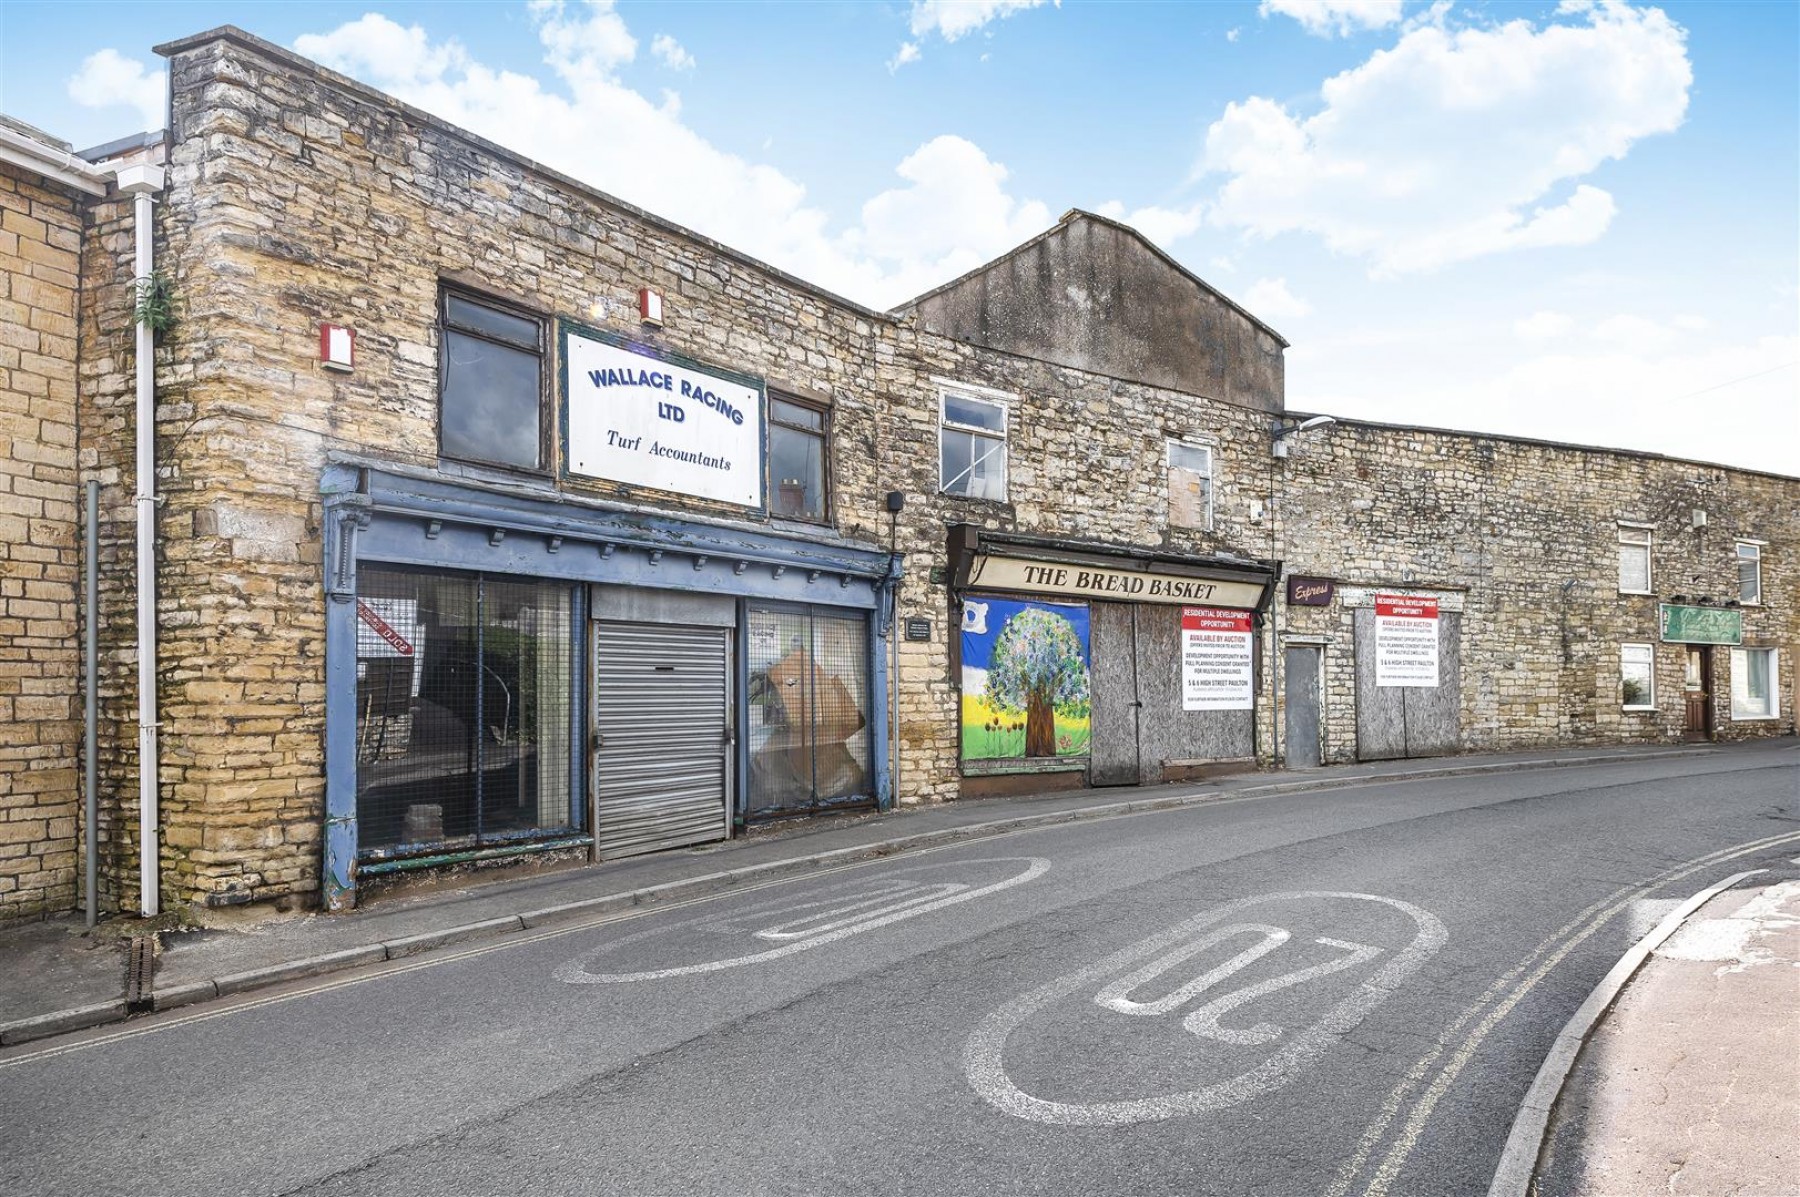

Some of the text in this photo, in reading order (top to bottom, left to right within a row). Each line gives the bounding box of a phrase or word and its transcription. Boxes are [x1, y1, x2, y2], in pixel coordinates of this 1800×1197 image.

[588, 368, 744, 425] WALLACE RACING
[658, 402, 685, 423] LTD
[607, 430, 731, 471] Turf Accountants
[1024, 566, 1216, 600] THE BREAD BASKET
[1295, 581, 1329, 601] Express
[1184, 608, 1250, 619] RESIDENTIAL DEVELOPMENT
[1094, 923, 1385, 1046] 20
